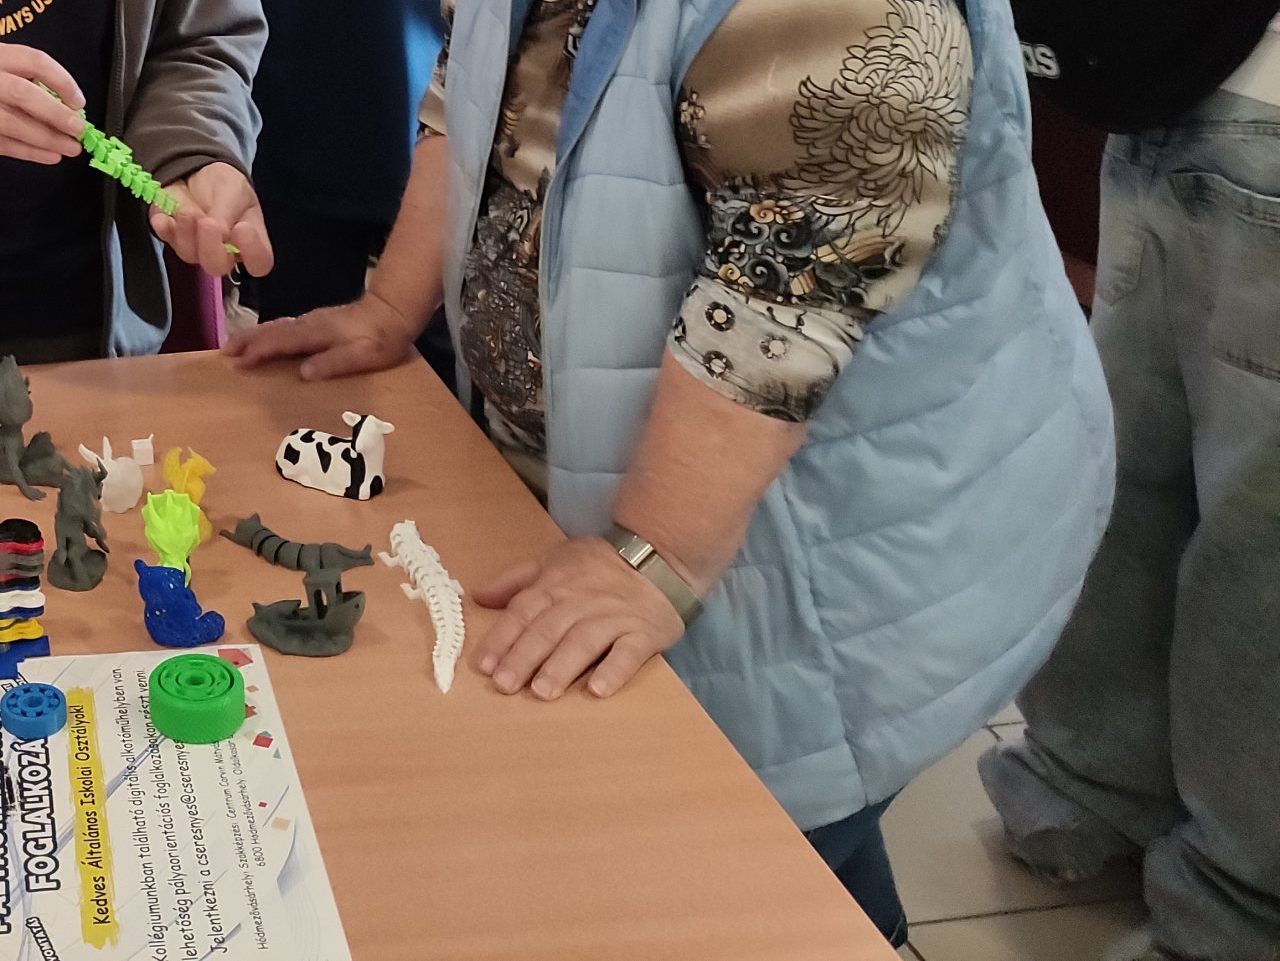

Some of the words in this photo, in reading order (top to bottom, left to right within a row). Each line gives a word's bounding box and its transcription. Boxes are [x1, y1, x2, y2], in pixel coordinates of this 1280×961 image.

[112, 668, 122, 684] van
[69, 705, 91, 761] Osztályok!
[111, 686, 136, 762] alkotóműhelyben
[143, 722, 170, 799] foglalkozásokon
[211, 740, 225, 764] Mátyá
[216, 766, 230, 787] Corvin
[76, 766, 95, 806] Iskolai
[121, 765, 146, 806] digitális
[172, 738, 210, 866] cseresnyes@cseresnyes
[221, 789, 237, 819] Centrum
[10, 737, 60, 892] FOGLALKOZÁ
[80, 810, 103, 869] Általános
[129, 810, 151, 859] található
[156, 802, 190, 896] pályaorientációs
[229, 822, 250, 869] Szakképzési
[251, 846, 266, 867] 6800
[200, 869, 211, 877] a
[91, 876, 111, 925] Kedves
[141, 862, 168, 961] Kollégiumunkban
[198, 880, 228, 954] Jelentkezni
[241, 871, 269, 950] Hódmezővásárhelyi
[172, 899, 198, 961] lehetőség
